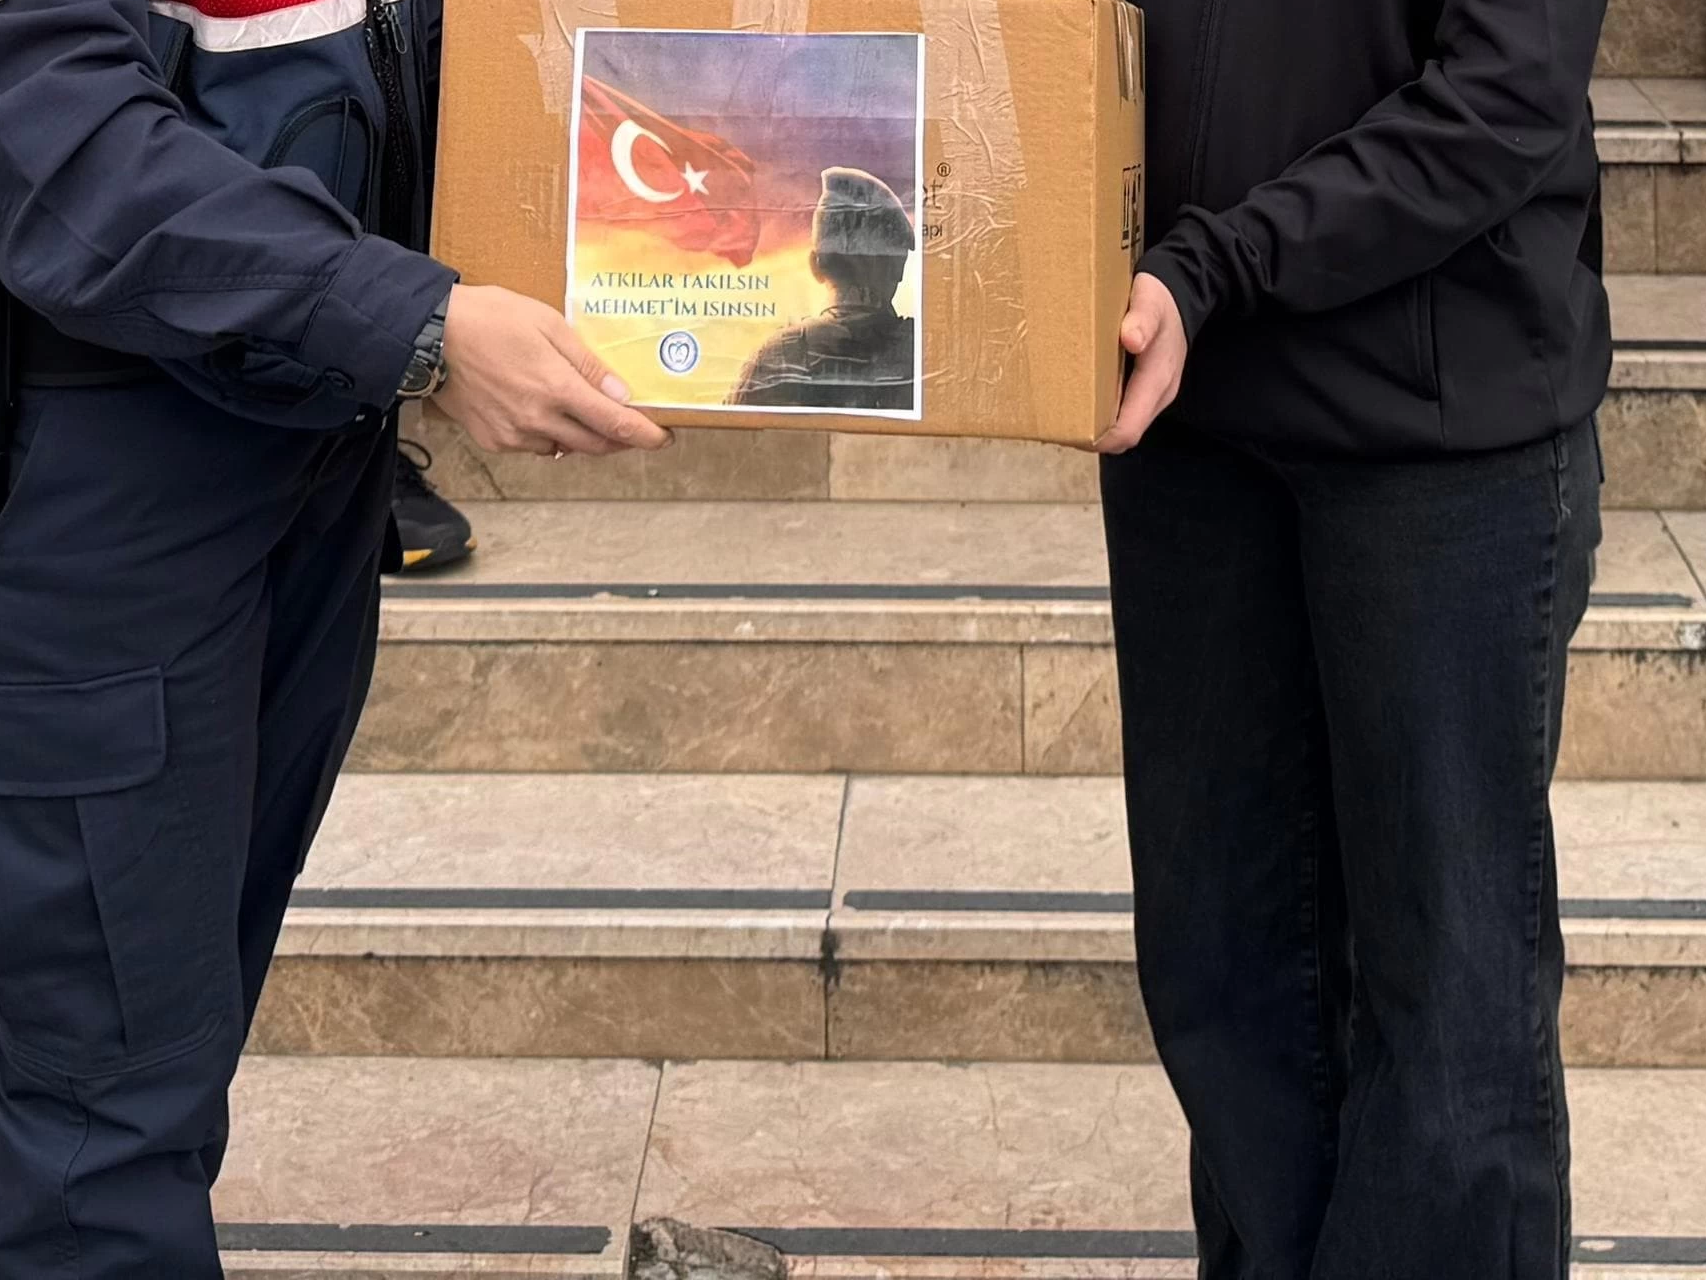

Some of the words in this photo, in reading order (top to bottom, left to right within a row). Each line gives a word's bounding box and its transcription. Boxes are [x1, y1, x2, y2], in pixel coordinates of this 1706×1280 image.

[591, 272, 674, 289] ATKILAR
[680, 273, 770, 290] TAKILSIN
[584, 297, 698, 317] MEHMET'İM
[703, 301, 776, 317] ISINSIN
